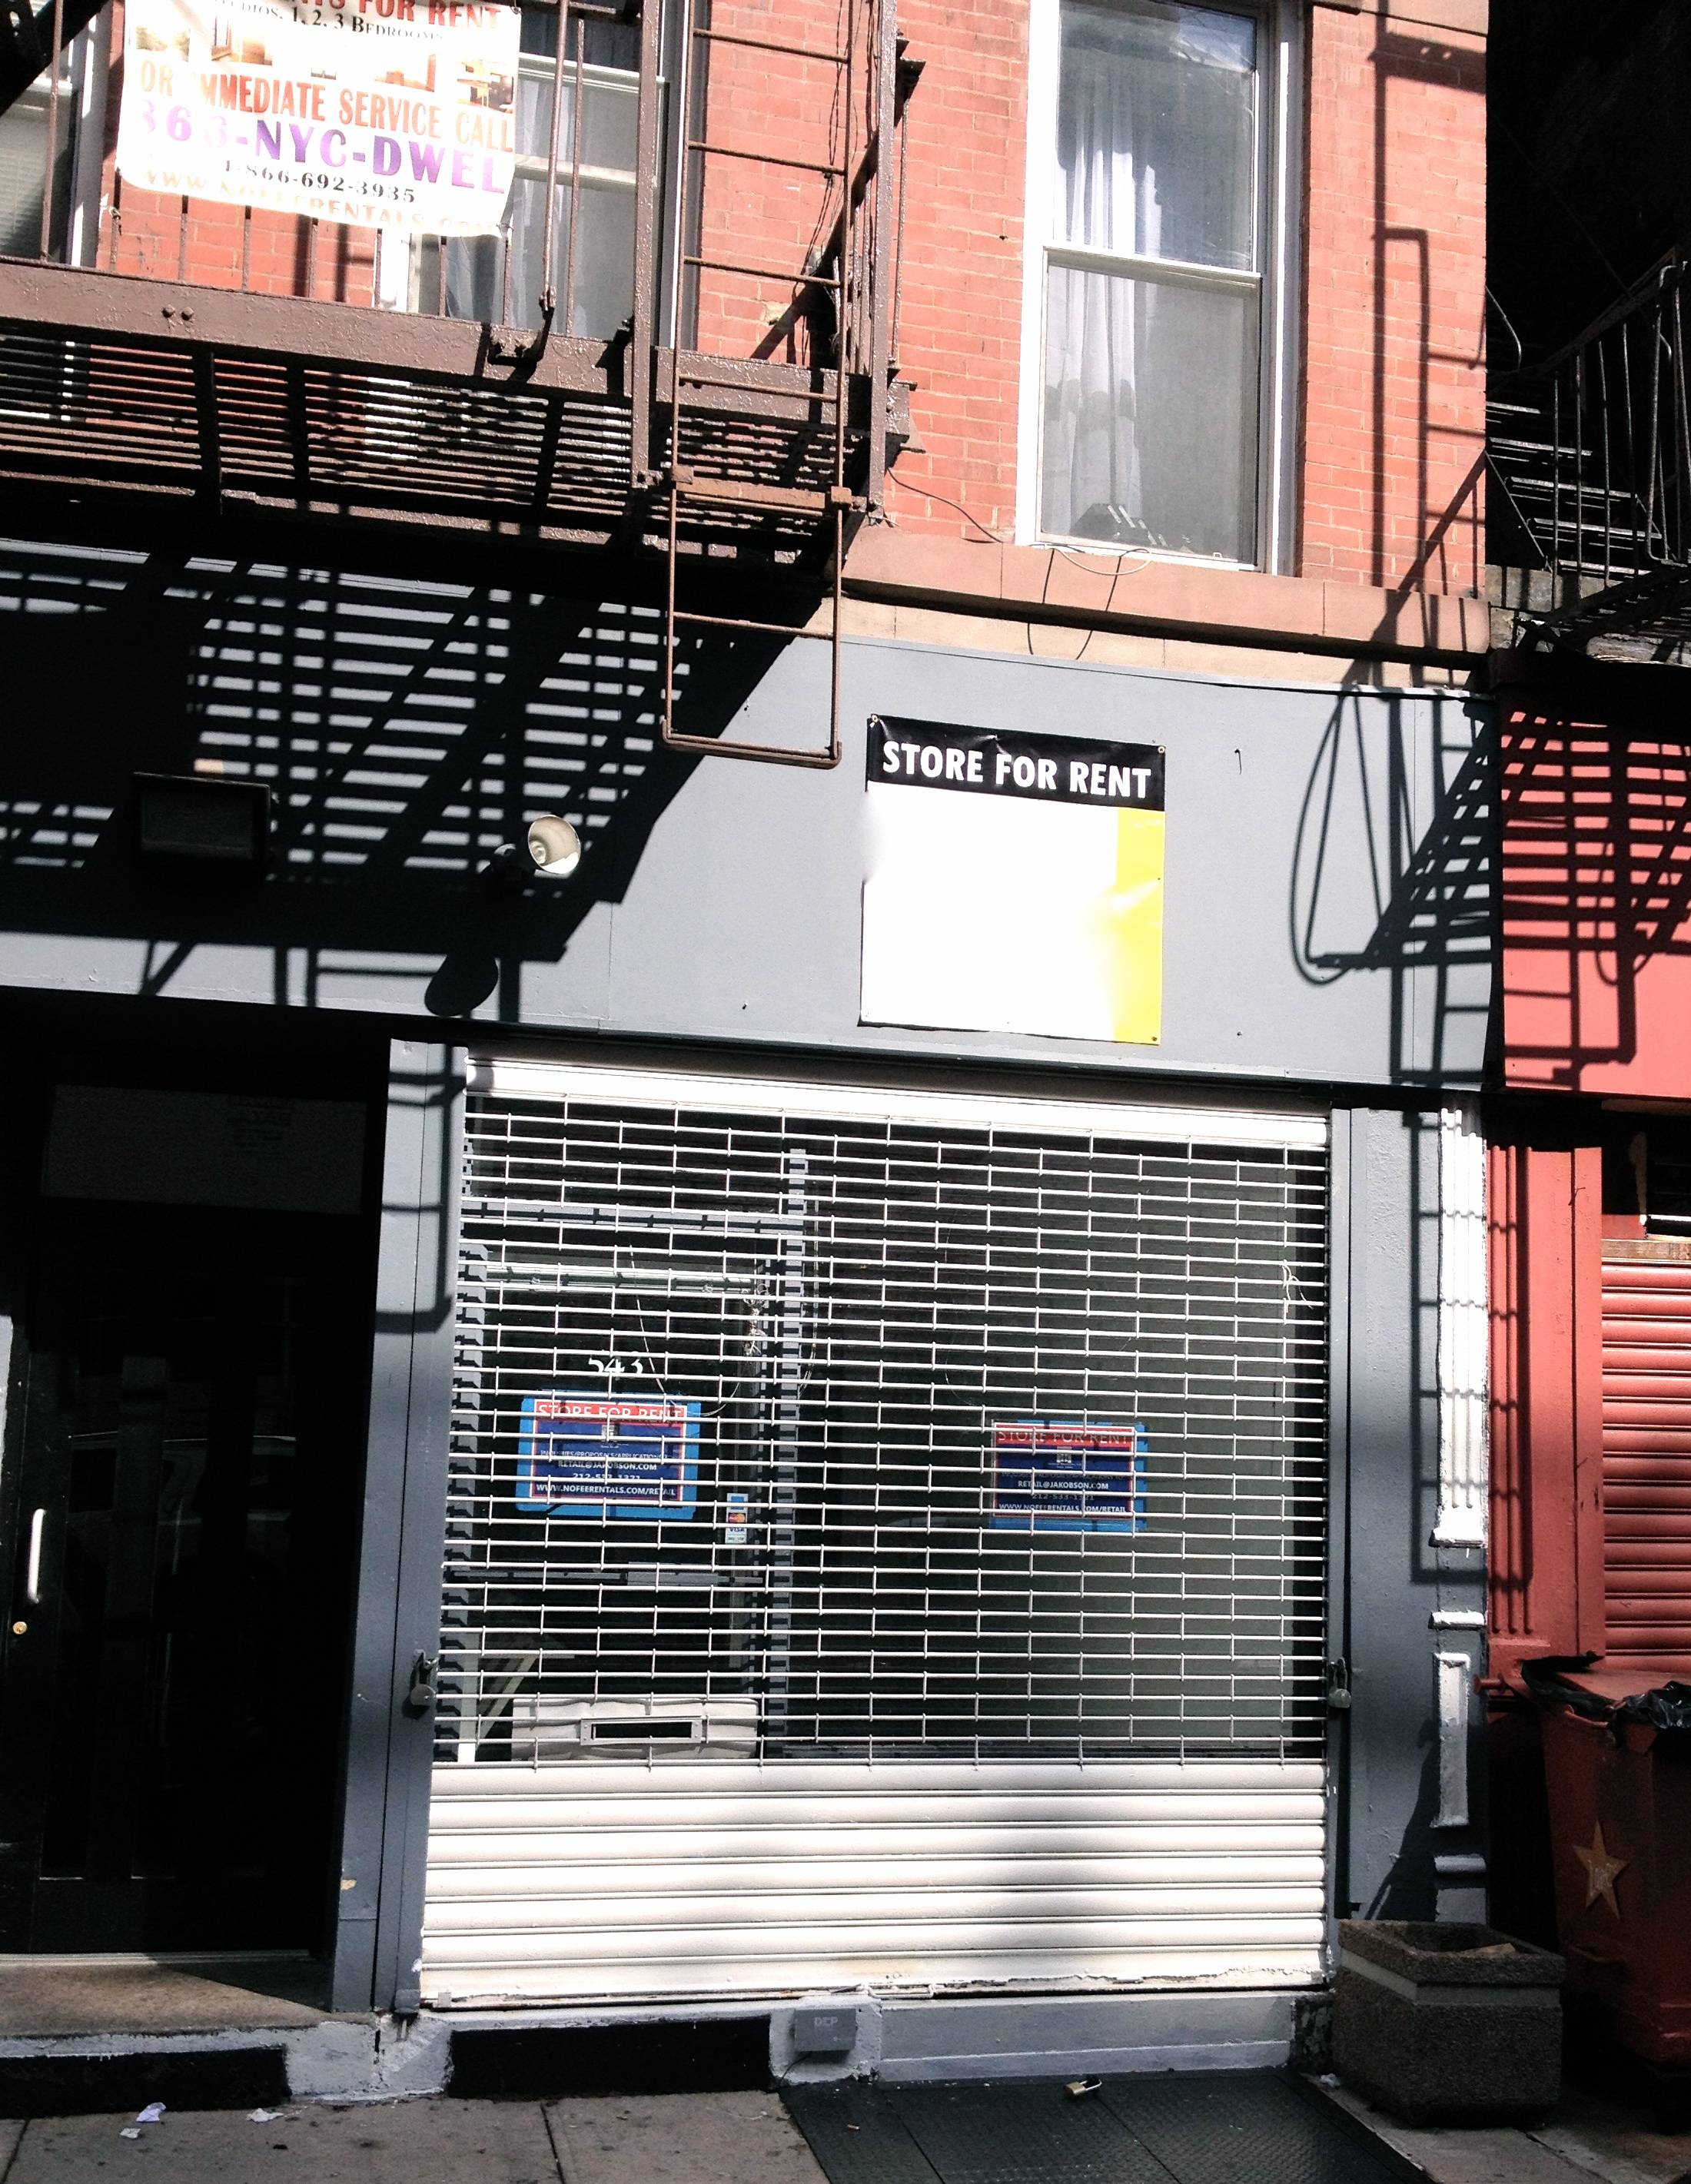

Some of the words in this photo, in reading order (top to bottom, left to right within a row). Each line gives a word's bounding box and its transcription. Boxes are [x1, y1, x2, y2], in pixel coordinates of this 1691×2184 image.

[335, 12, 344, 29] 3
[358, 0, 414, 22] FOR
[428, 3, 502, 29] RENT
[140, 61, 173, 97] OR
[198, 73, 326, 121] MMEDIATE
[338, 88, 441, 139] SERVICE
[455, 111, 513, 153] CALL
[882, 740, 984, 783] STORE
[995, 754, 1058, 790] FOR
[1069, 762, 1152, 799] RENT
[538, 1405, 592, 1419] STORE
[599, 1406, 631, 1419] FOR
[639, 1409, 682, 1422] RENT
[998, 1429, 1045, 1442] STORE
[1054, 1431, 1084, 1443] FOR
[1089, 1432, 1128, 1445] RENT
[537, 1484, 676, 1495] WWW.NOFEERENTALS.COM/RETAIL
[998, 1503, 1127, 1513] WWW.NOFEERENTALS.OM/RETAIL
[813, 2016, 839, 2027] DEP
